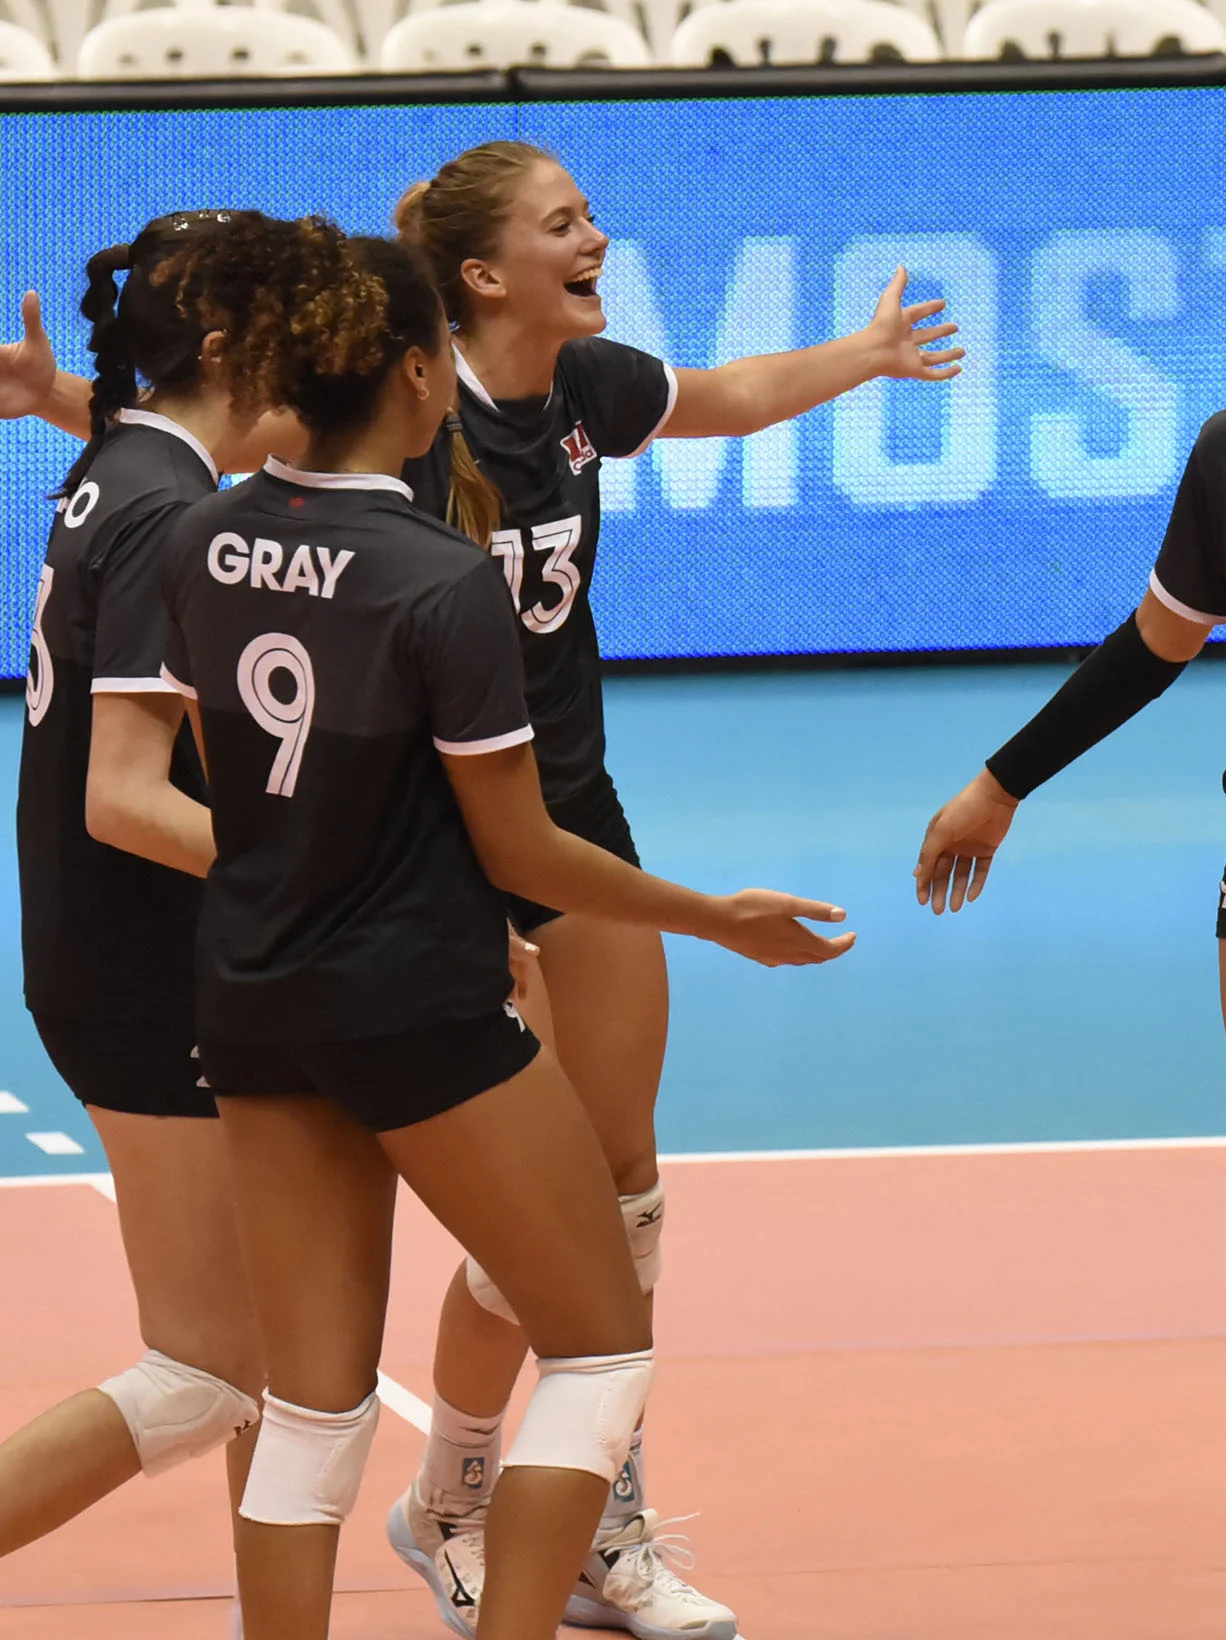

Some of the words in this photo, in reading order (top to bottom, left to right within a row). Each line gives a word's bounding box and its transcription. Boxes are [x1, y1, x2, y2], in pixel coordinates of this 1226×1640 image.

[207, 531, 356, 600] GRAY
[491, 514, 582, 634] 13
[236, 632, 315, 798] 9
